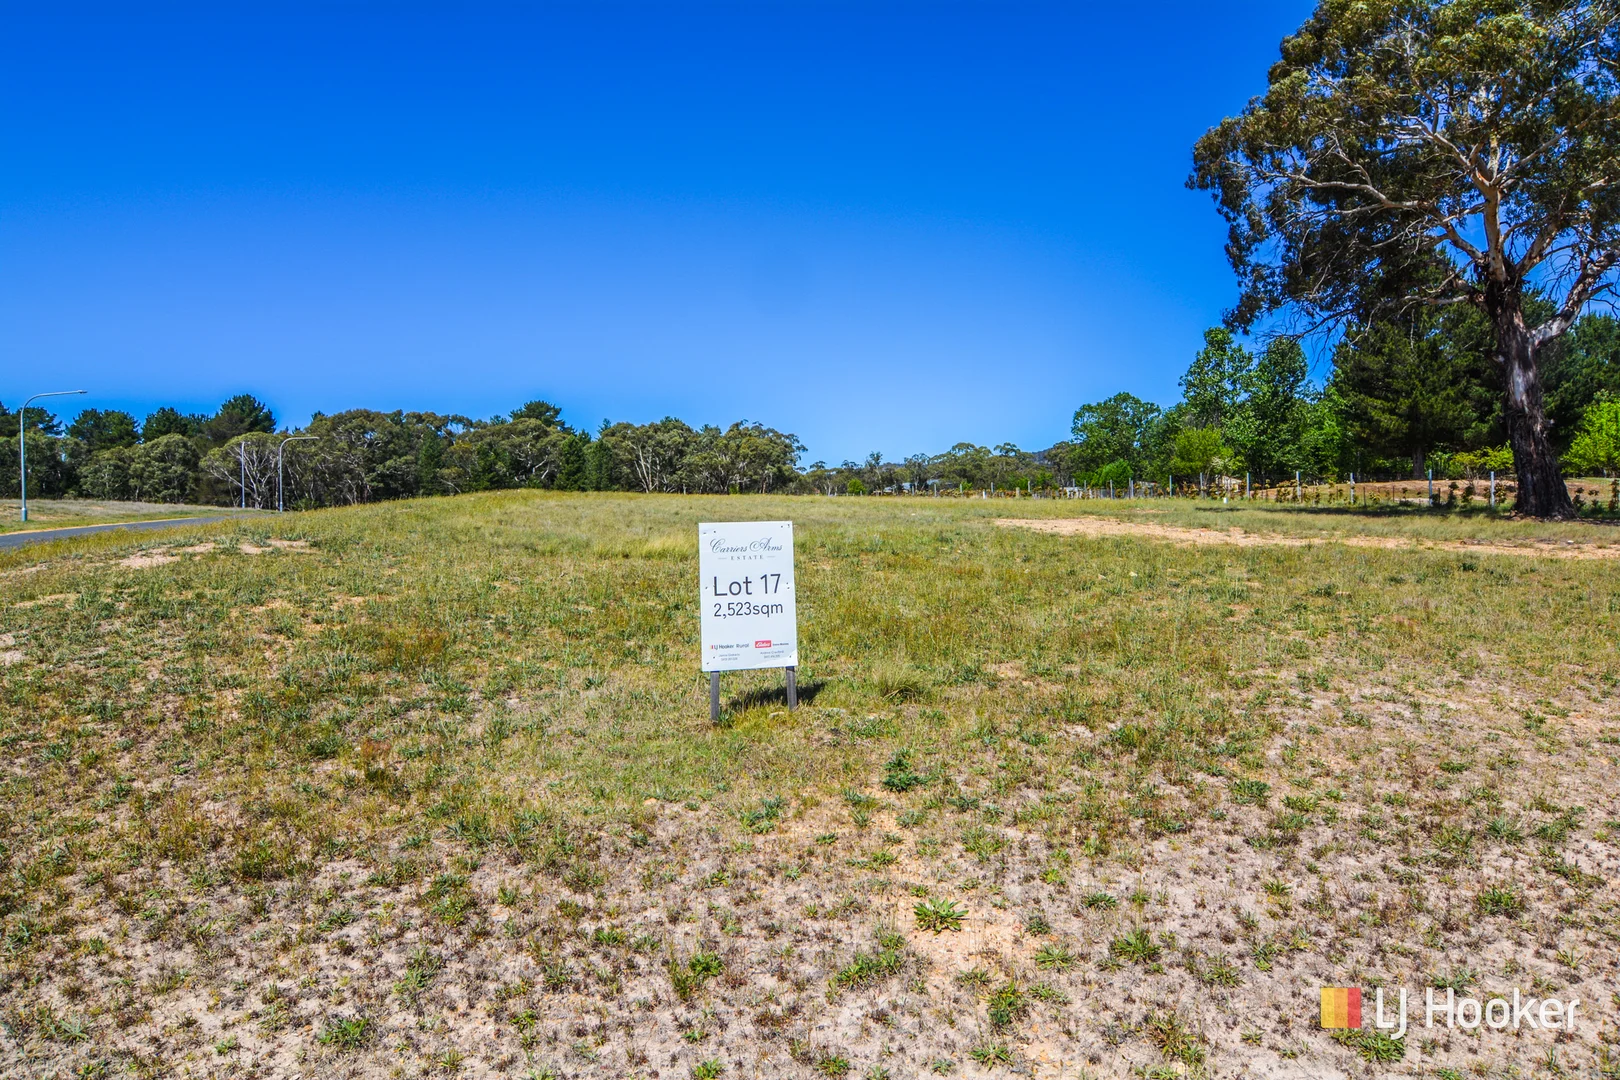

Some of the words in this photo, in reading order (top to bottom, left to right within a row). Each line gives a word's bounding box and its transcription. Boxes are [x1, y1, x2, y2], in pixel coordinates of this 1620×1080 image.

[709, 538, 748, 553] Carriers
[749, 537, 783, 552] Arms
[713, 576, 753, 597] Lot
[760, 573, 781, 595] 17
[713, 601, 783, 620] 2,523sqm
